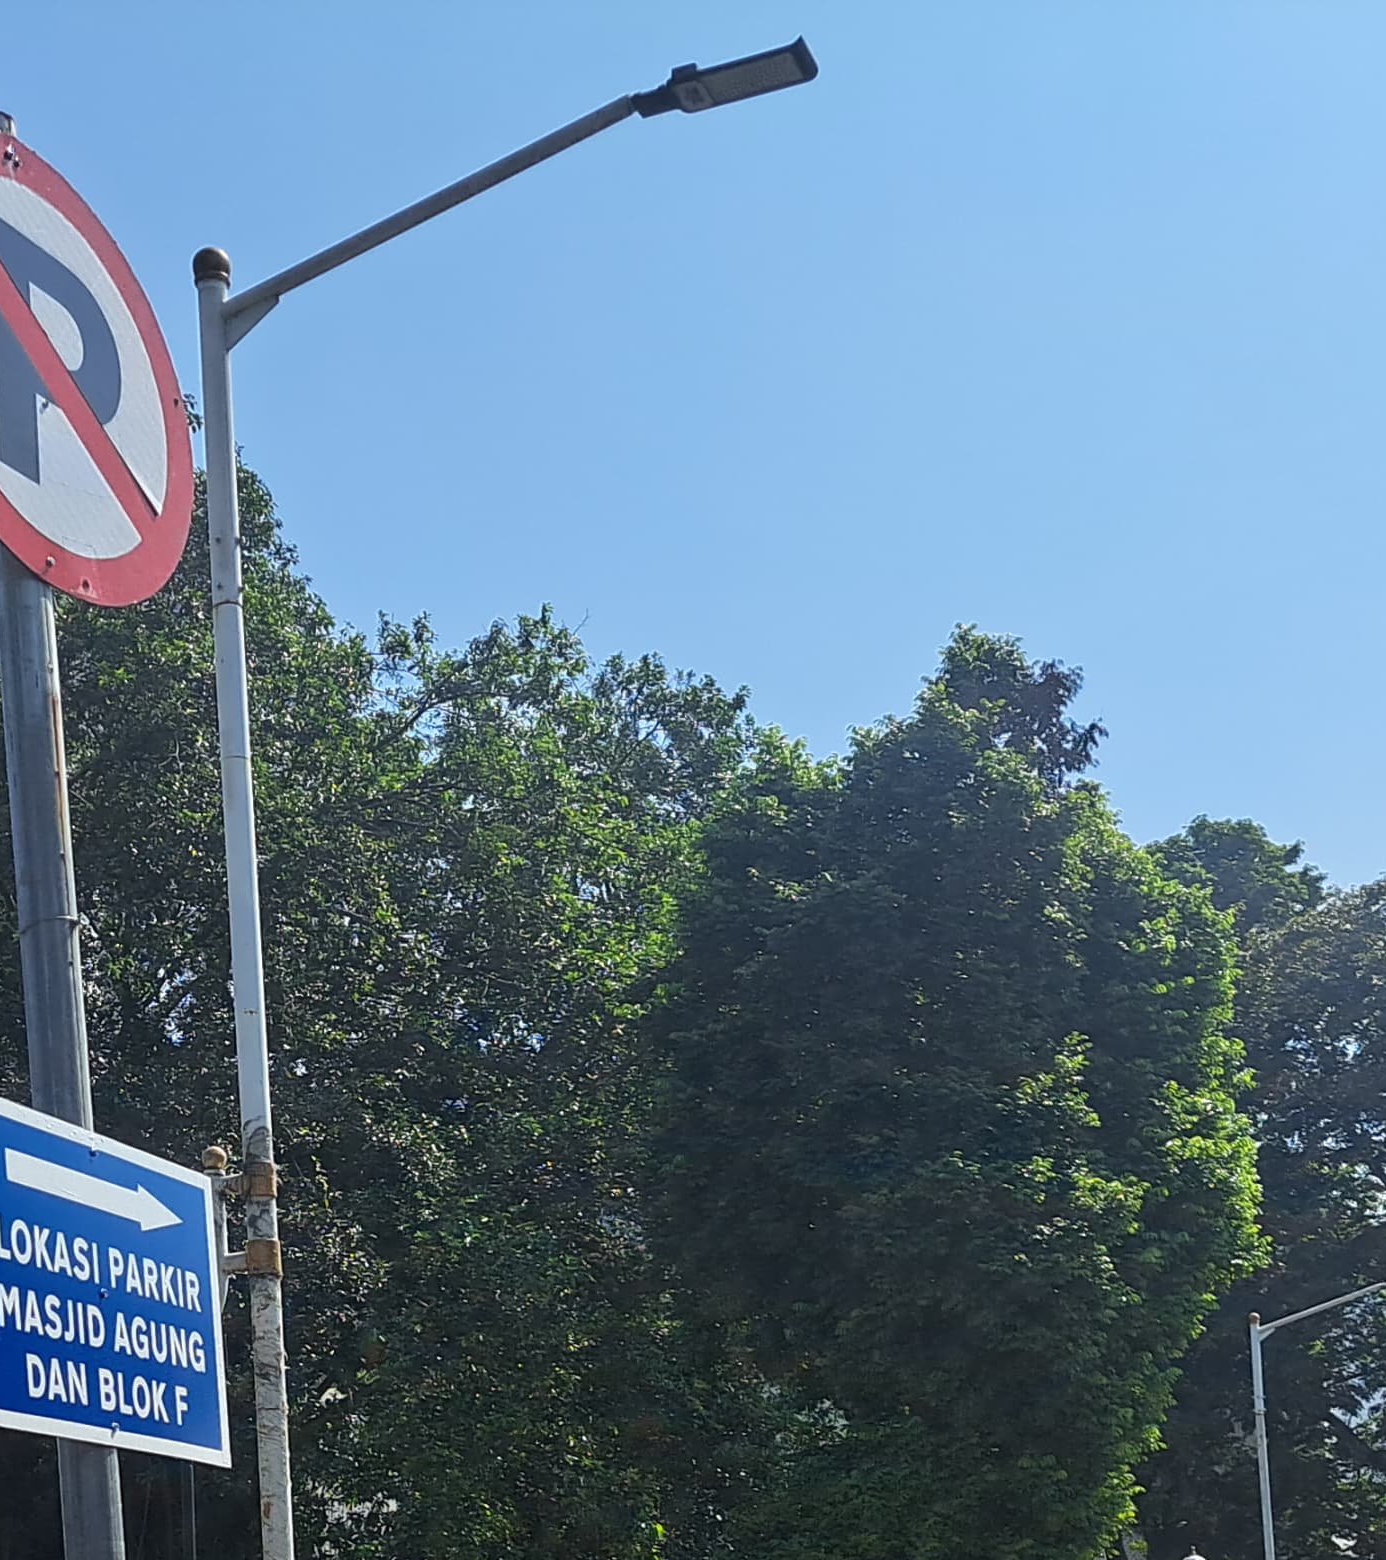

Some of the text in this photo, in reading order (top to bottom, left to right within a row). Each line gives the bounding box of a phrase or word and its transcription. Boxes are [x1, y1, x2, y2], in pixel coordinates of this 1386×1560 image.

[108, 1246, 202, 1313] PARKIR
[114, 1313, 207, 1373] AGUNG
[25, 1353, 189, 1427] DAN BLOK F
